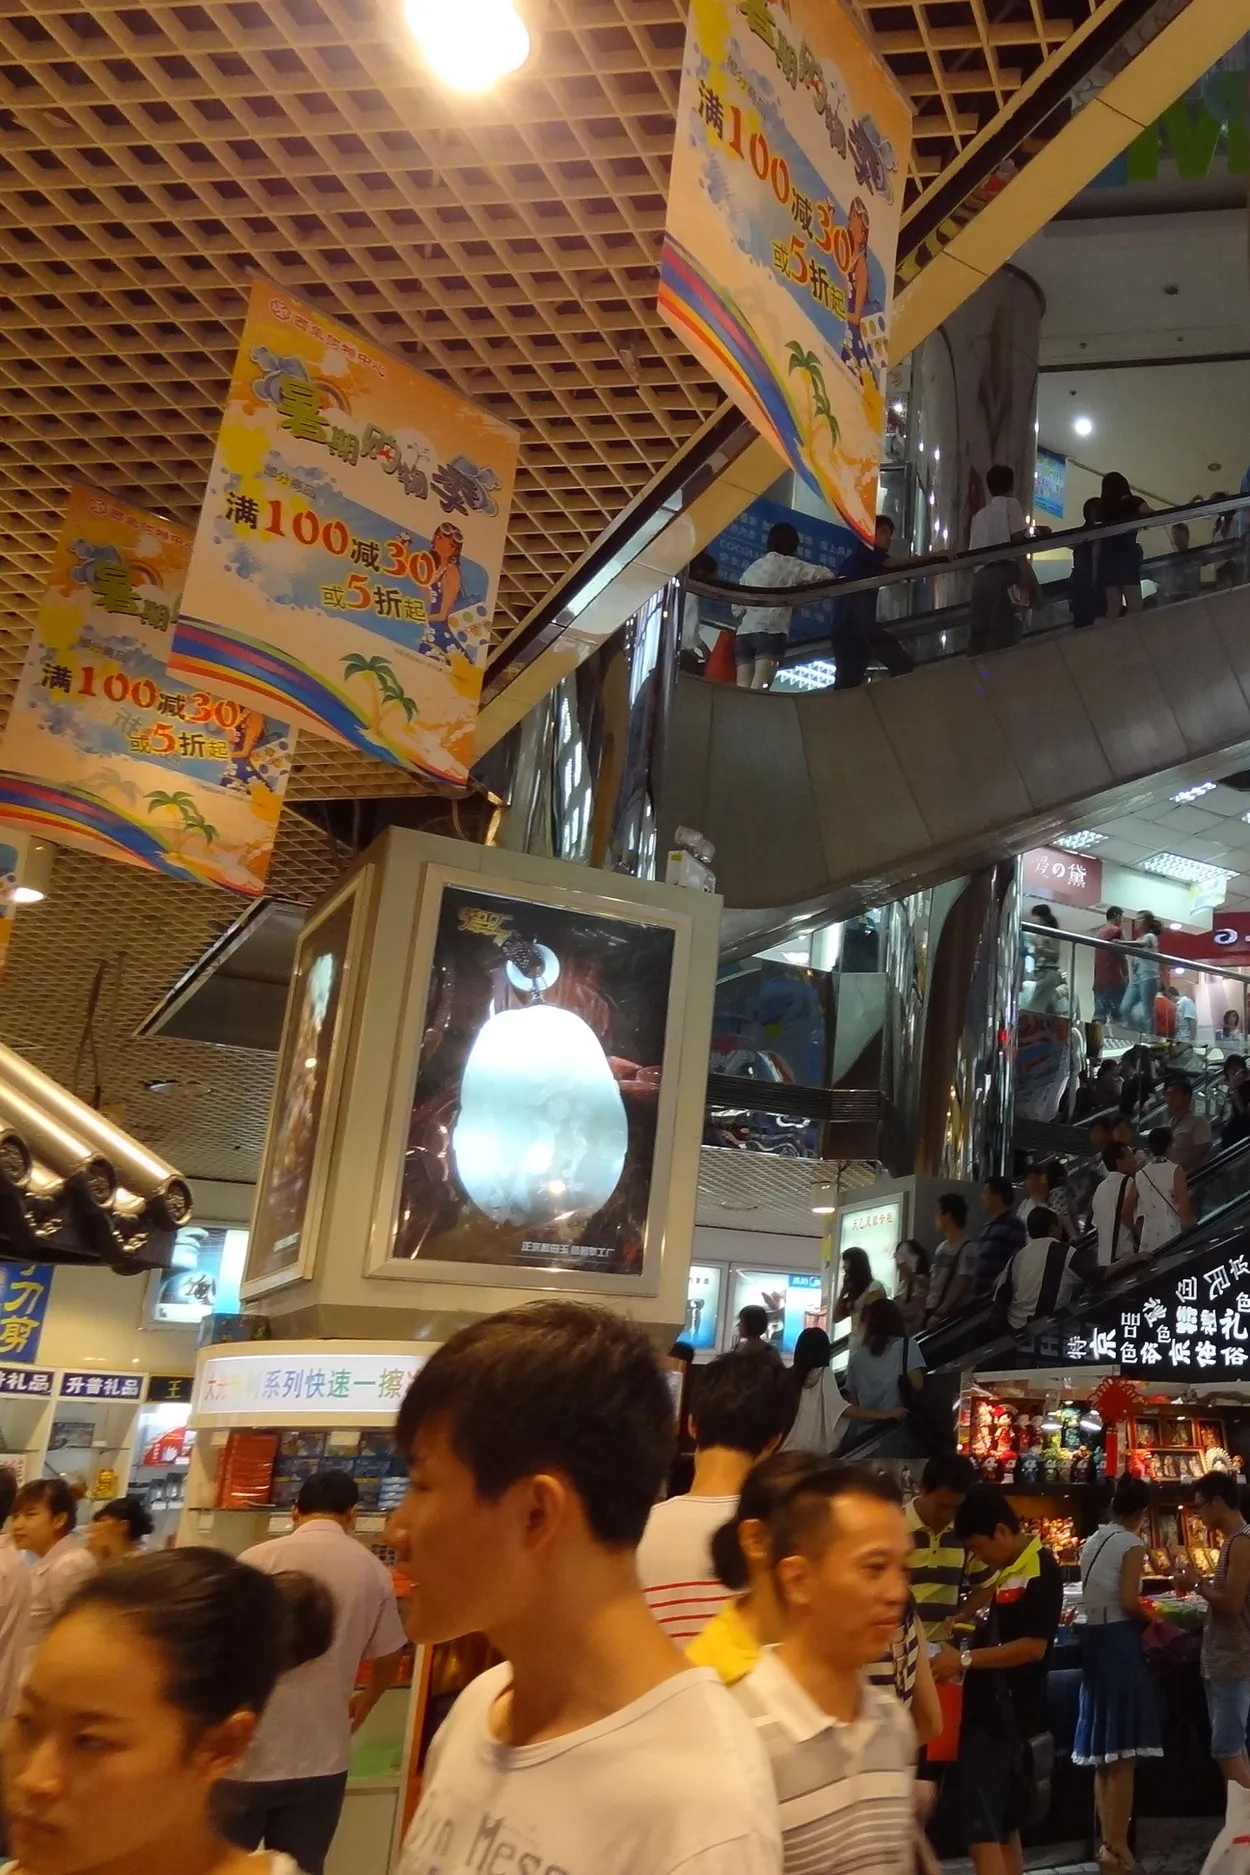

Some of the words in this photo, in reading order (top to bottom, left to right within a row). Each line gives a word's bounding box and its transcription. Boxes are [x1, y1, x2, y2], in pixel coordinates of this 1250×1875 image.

[773, 235, 846, 320] 或5折起
[225, 491, 436, 588] 满100减30
[320, 572, 429, 623] 或5折起
[128, 721, 230, 760] 或5折起
[0, 1264, 44, 1353] 刀剪
[0, 1372, 50, 1392] 礼品
